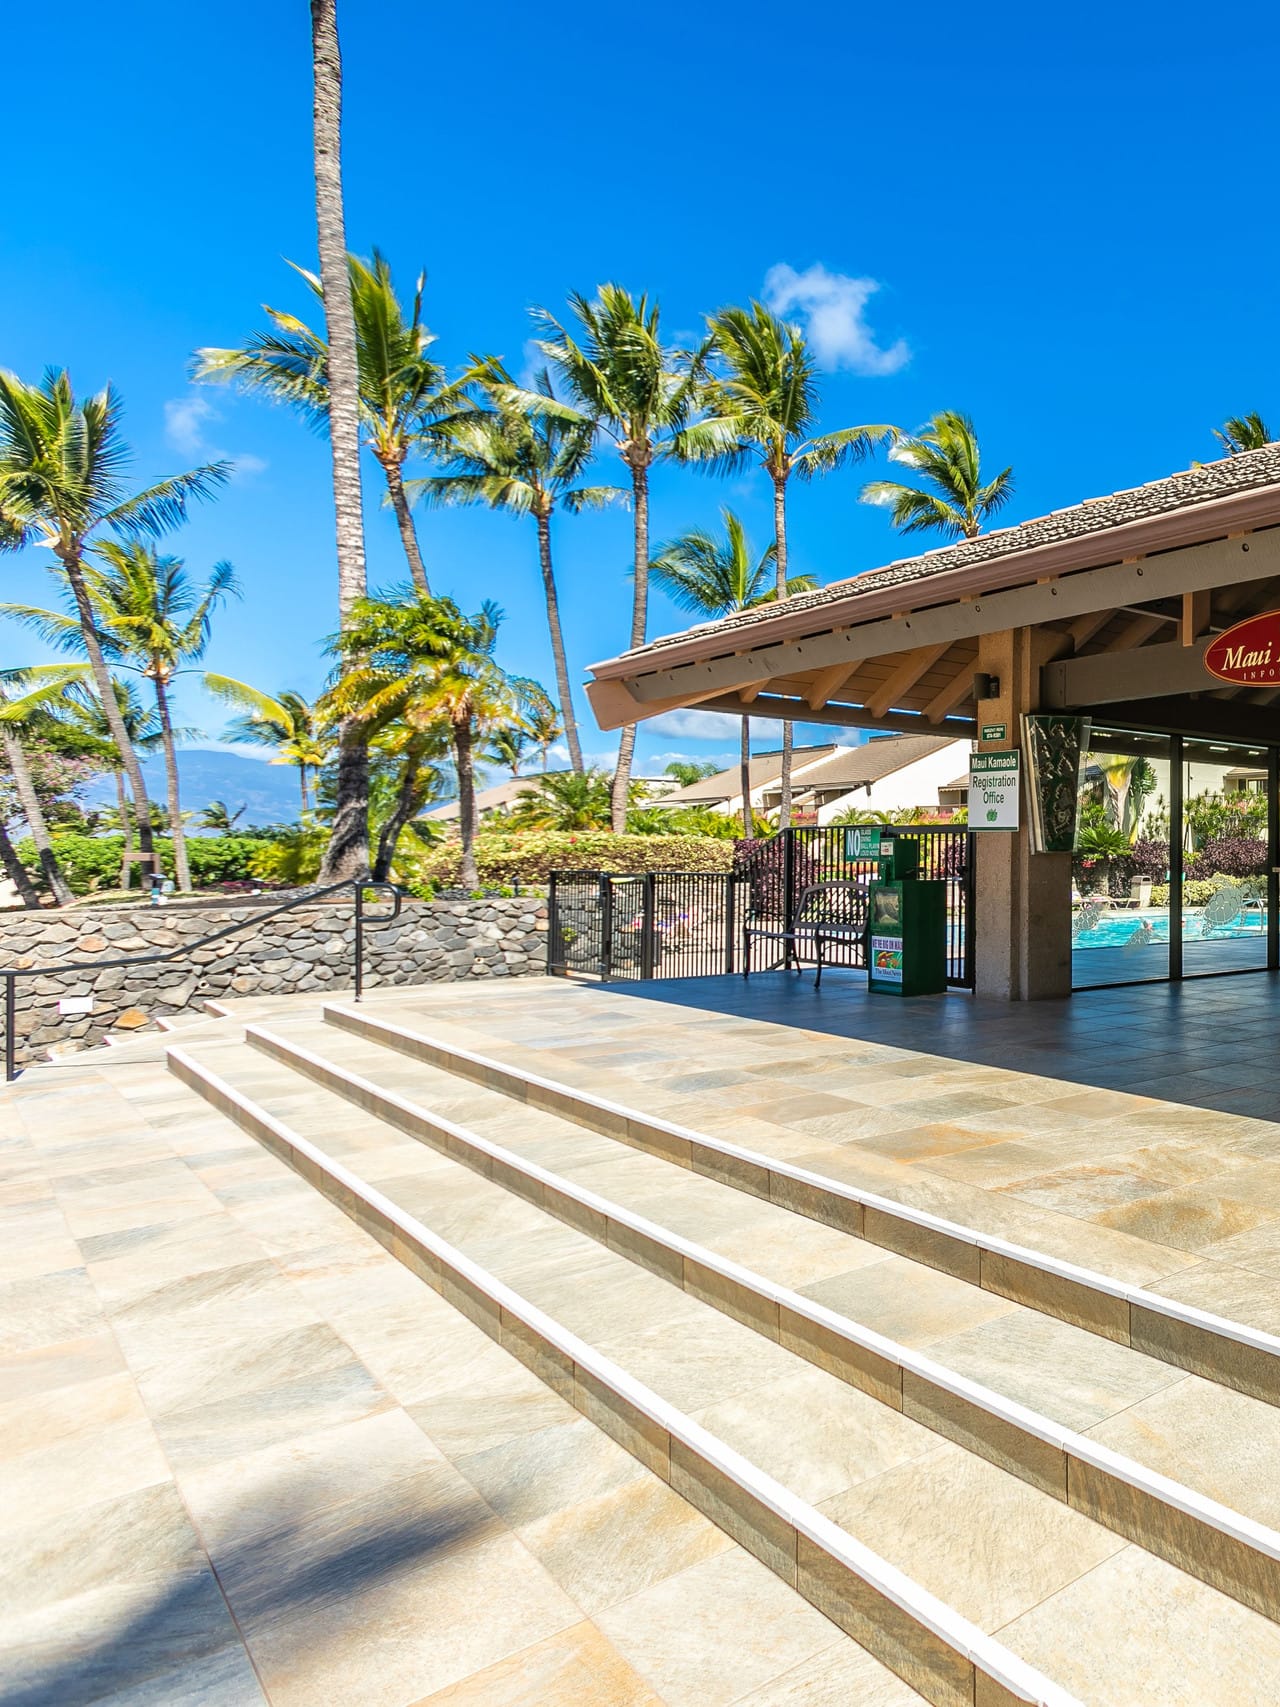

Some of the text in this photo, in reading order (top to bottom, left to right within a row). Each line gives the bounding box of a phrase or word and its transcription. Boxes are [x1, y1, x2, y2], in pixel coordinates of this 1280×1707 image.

[1221, 642, 1273, 671] Maui
[972, 755, 1016, 768] Maui Kamaole
[972, 774, 1016, 791] Registration
[983, 791, 1005, 804] Office
[847, 829, 861, 857] NO
